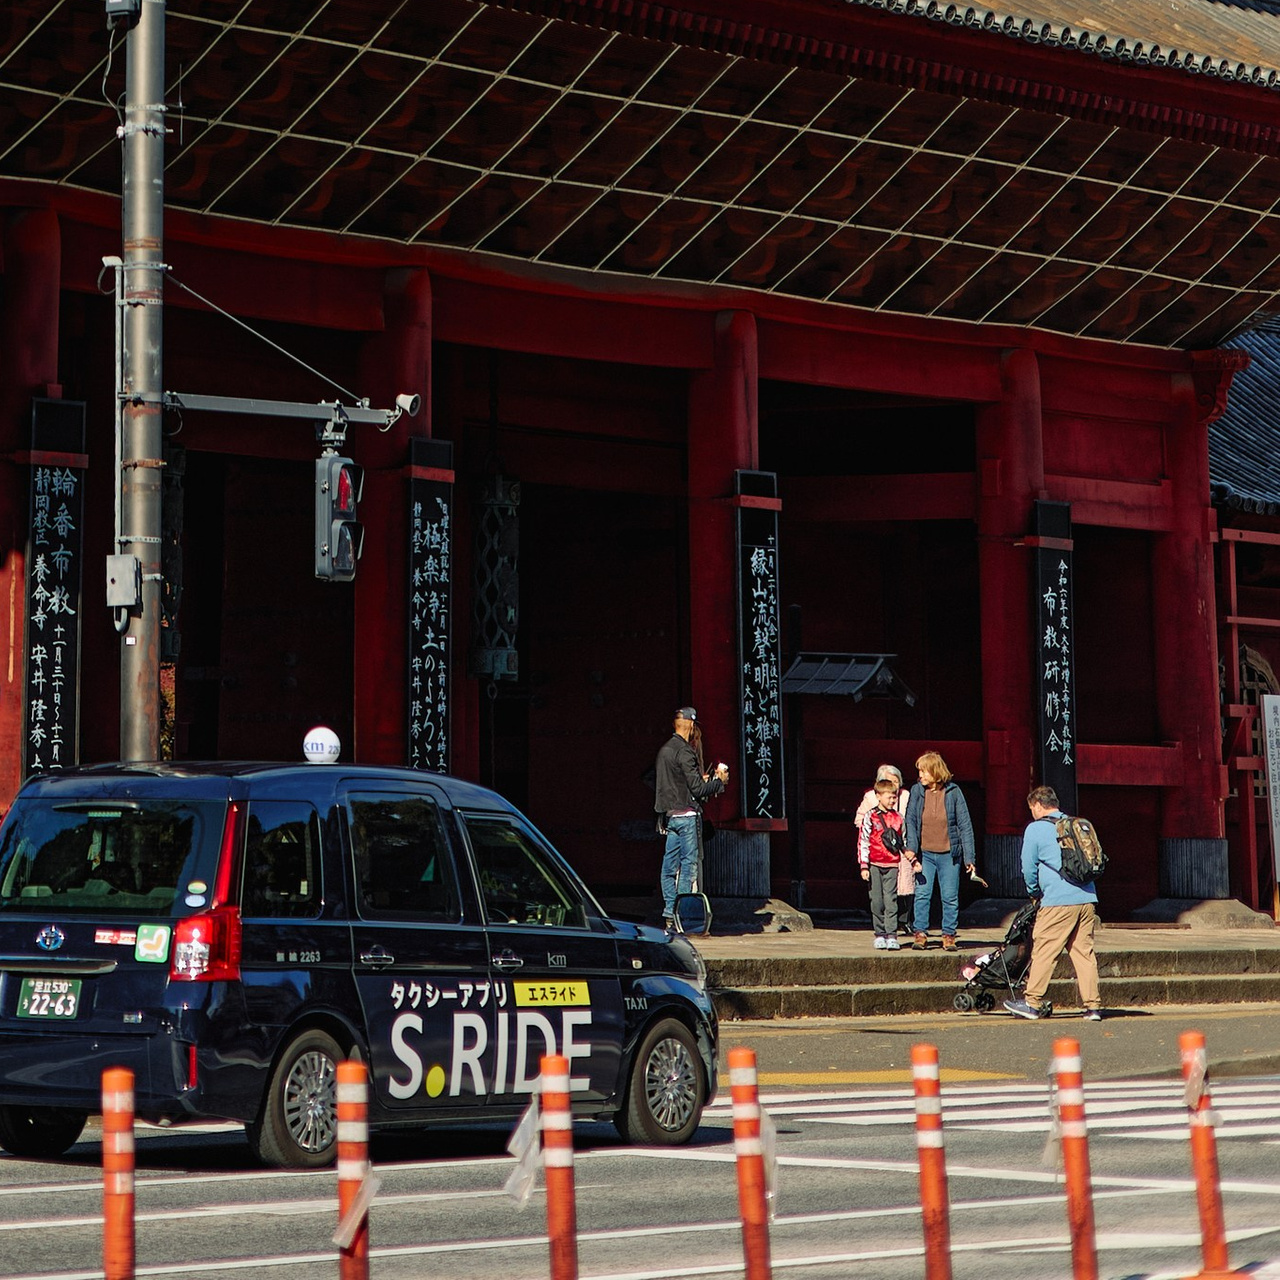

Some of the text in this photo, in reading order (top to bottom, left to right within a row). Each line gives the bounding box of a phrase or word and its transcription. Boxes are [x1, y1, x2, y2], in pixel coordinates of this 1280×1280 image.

[46, 467, 78, 615] 輪番布教
[1043, 586, 1062, 752] 布教研修会
[29, 643, 49, 773] 安井隆秀上
[300, 950, 321, 962] 2263
[547, 952, 567, 966] km
[390, 980, 507, 1009] タクシーアプリ
[528, 986, 577, 1002] エスライド
[624, 997, 648, 1010] TAXI
[388, 1010, 593, 1100] S.RIDE
